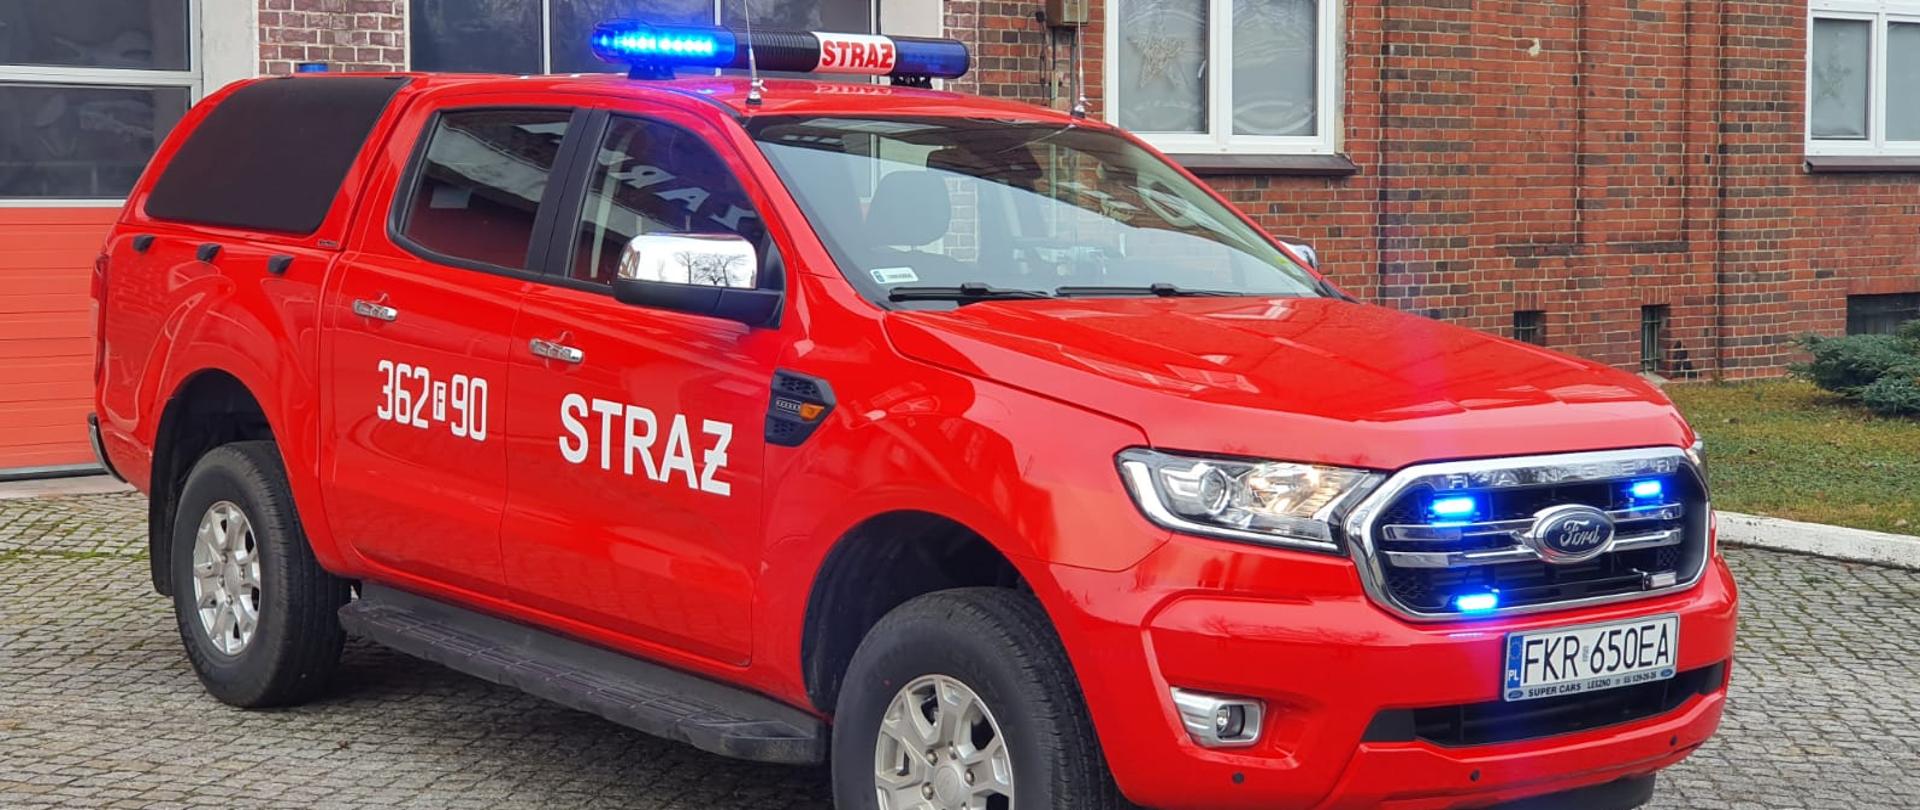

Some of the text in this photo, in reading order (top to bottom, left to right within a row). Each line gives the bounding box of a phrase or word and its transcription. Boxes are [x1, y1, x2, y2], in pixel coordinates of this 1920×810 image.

[377, 359, 487, 441] 362 F 90
[1560, 520, 1600, 546] Ford
[1523, 623, 1669, 684] FKR 650EA
[1508, 669, 1519, 681] PL
[1528, 685, 1557, 697] SUPER
[1559, 682, 1581, 693] CARS
